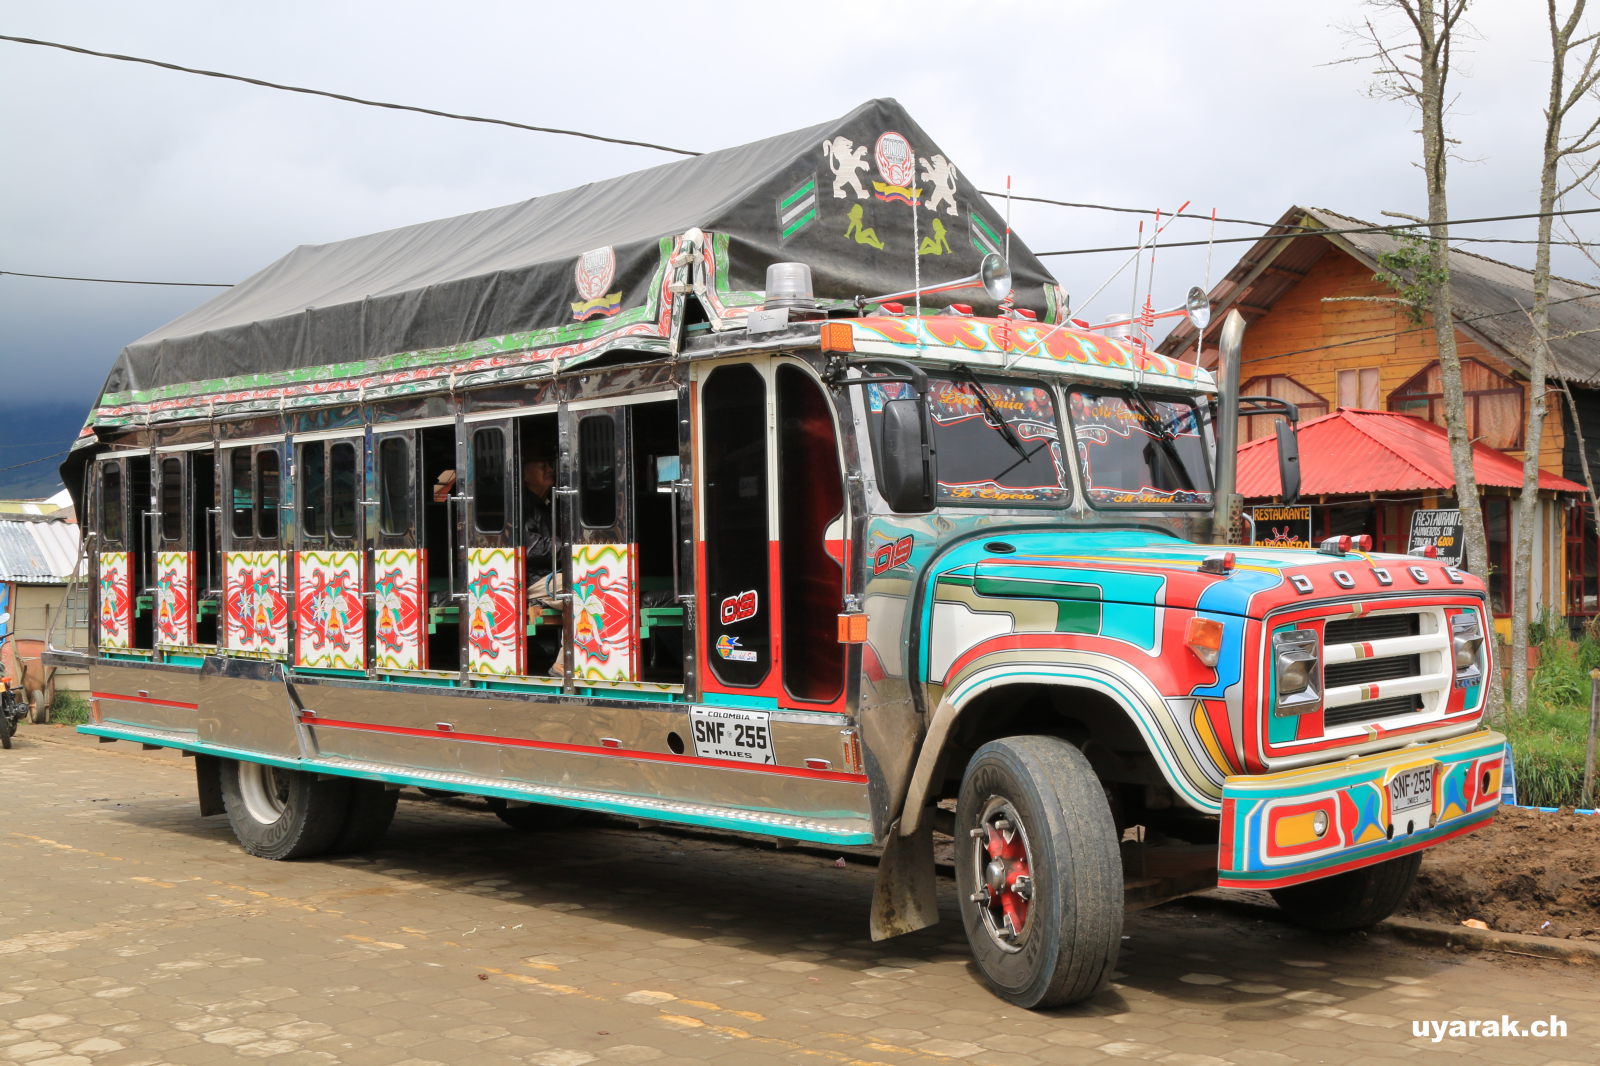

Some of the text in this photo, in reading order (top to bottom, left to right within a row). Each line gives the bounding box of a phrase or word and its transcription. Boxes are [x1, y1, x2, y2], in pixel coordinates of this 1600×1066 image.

[1254, 508, 1310, 521] RESTAURANTE
[1415, 512, 1462, 526] RESTAURANTE
[1287, 566, 1464, 595] DODGE
[707, 711, 751, 721] COLOMBIA
[695, 720, 767, 750] SNF 255
